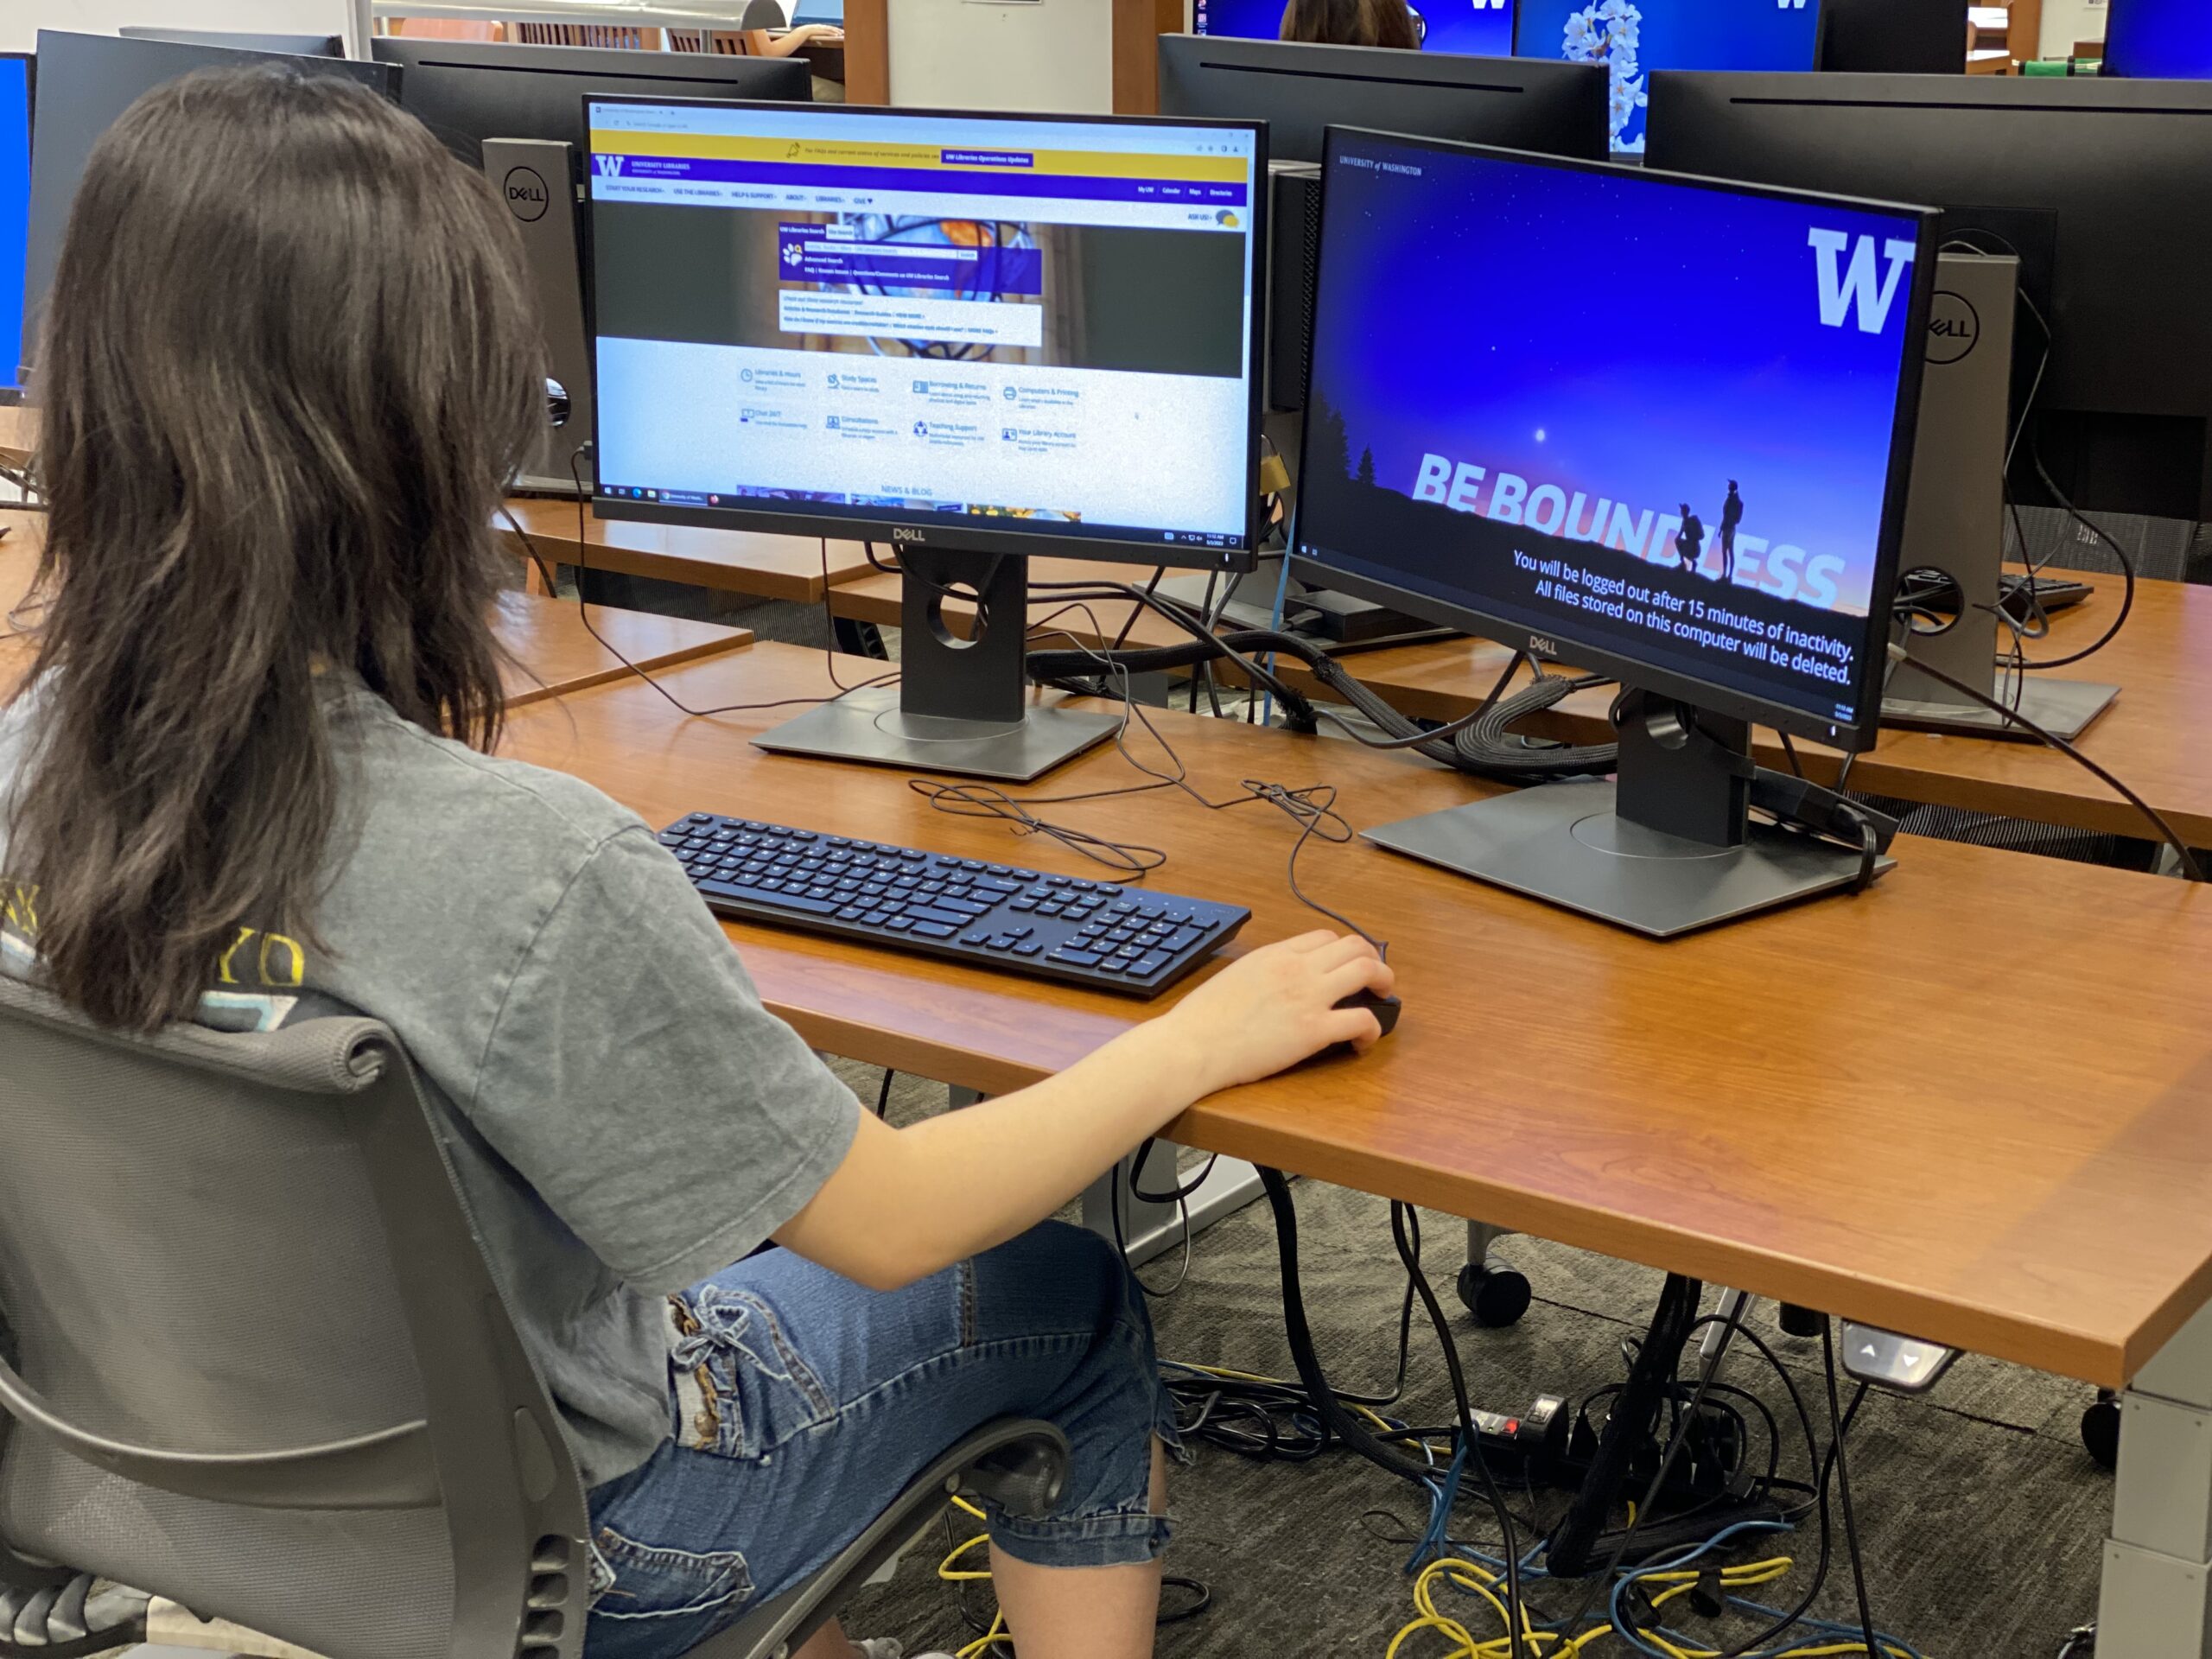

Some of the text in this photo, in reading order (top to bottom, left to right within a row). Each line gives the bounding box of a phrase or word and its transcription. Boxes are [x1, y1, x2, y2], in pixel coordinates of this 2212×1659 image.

[595, 155, 624, 176] W
[1339, 156, 1422, 176] UNIVERSITY of WASHINGTON
[509, 187, 544, 202] DELL
[1808, 227, 1916, 334] W
[1929, 318, 1980, 338] ELL
[881, 485, 903, 494] NEWS
[912, 487, 932, 496] BLOG
[893, 528, 925, 542] DELL
[1412, 453, 1847, 610] BE BOUNDLESS
[1514, 550, 1855, 664] You will be logged out after 15 minutes of inactivity.
[1535, 580, 1852, 686] All files stored on this computer will be deleted.
[1529, 635, 1558, 656] DELL
